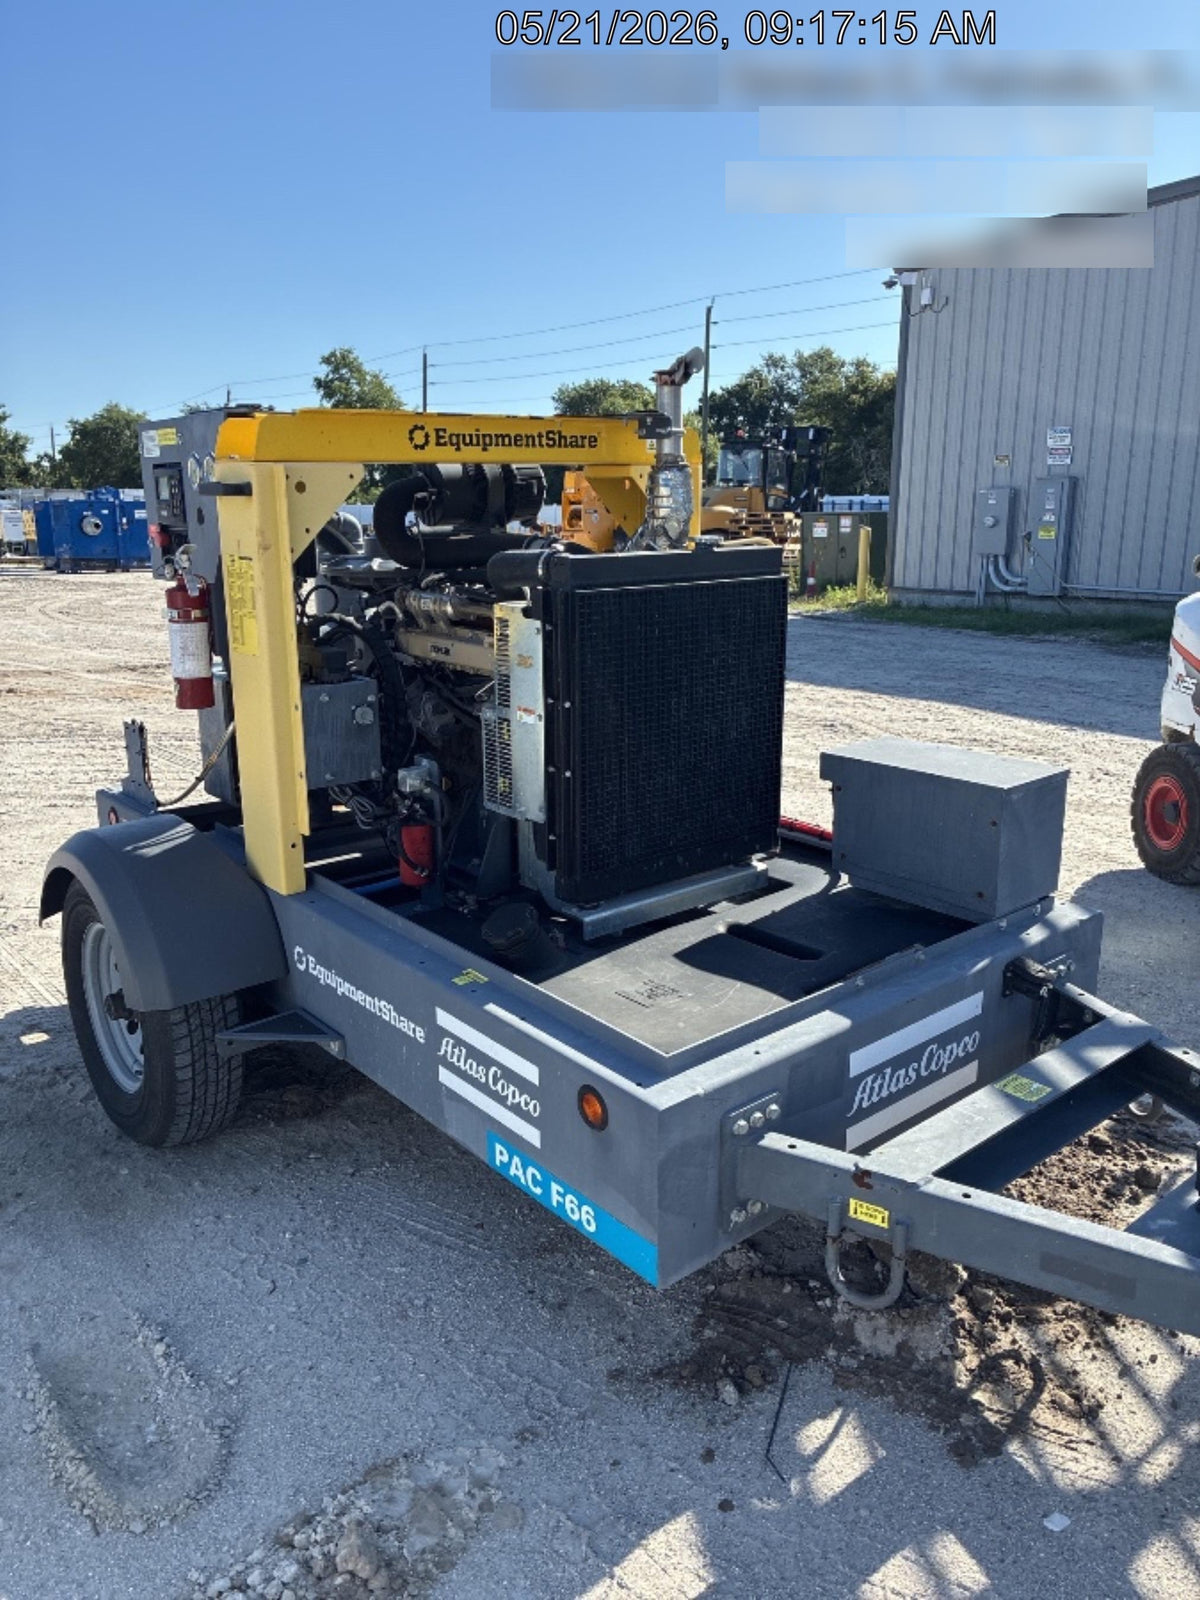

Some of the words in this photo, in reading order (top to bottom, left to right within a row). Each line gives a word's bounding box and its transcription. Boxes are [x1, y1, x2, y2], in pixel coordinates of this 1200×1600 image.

[434, 428, 599, 452] EquipmentShare
[306, 953, 426, 1043] EquipmentShare
[437, 1037, 486, 1084] Atlas
[488, 1066, 541, 1118] Copco
[846, 1061, 919, 1118] Atlas
[919, 1030, 981, 1074] Copco
[494, 1142, 543, 1196] PAC
[550, 1181, 597, 1233] F66
